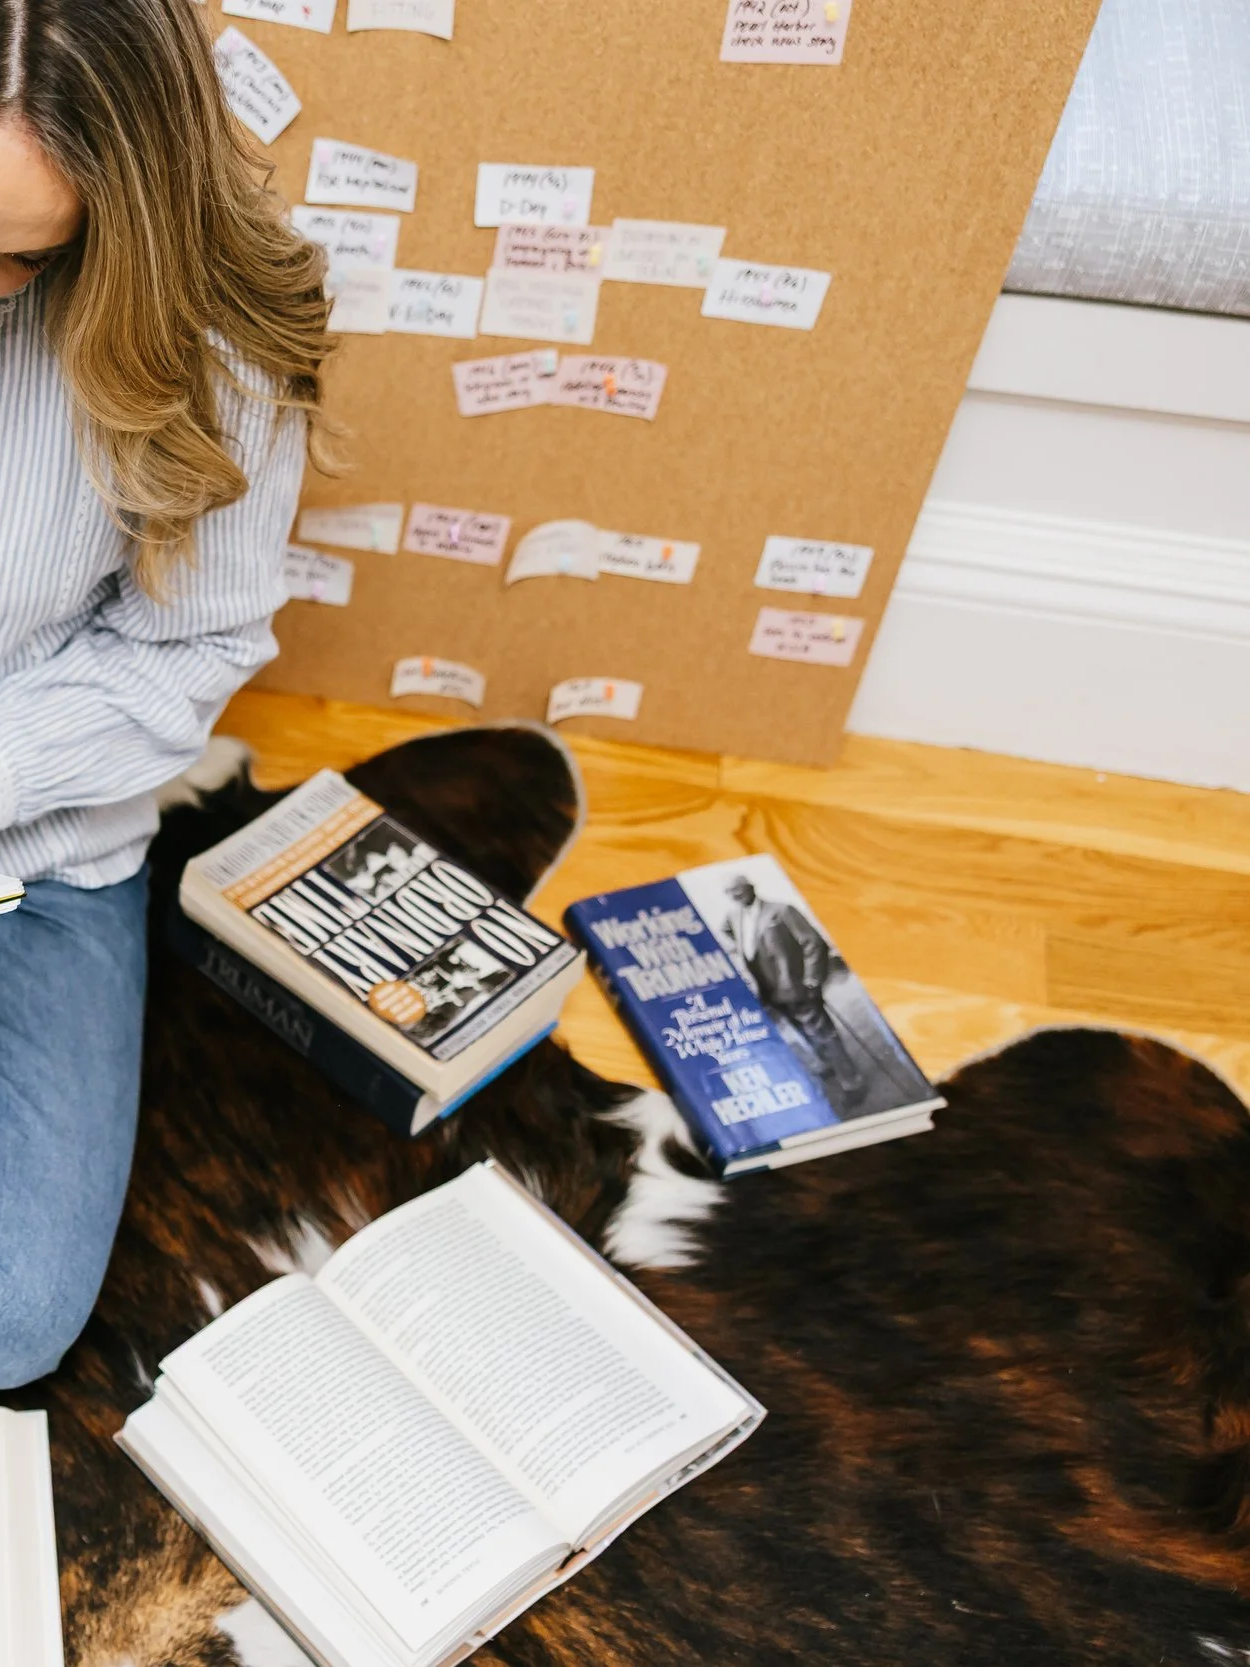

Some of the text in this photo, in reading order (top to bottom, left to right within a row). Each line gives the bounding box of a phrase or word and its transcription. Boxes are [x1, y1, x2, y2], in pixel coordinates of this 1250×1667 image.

[252, 869, 372, 956] TIME
[312, 860, 495, 1001] ORDINARY
[471, 898, 562, 967] NO
[591, 904, 704, 950] Working
[617, 950, 736, 1001] TRUMAN
[629, 935, 698, 970] With
[203, 942, 315, 1050] TRUMAN
[711, 1080, 812, 1126] HECHLER
[720, 1062, 773, 1097] KEN
